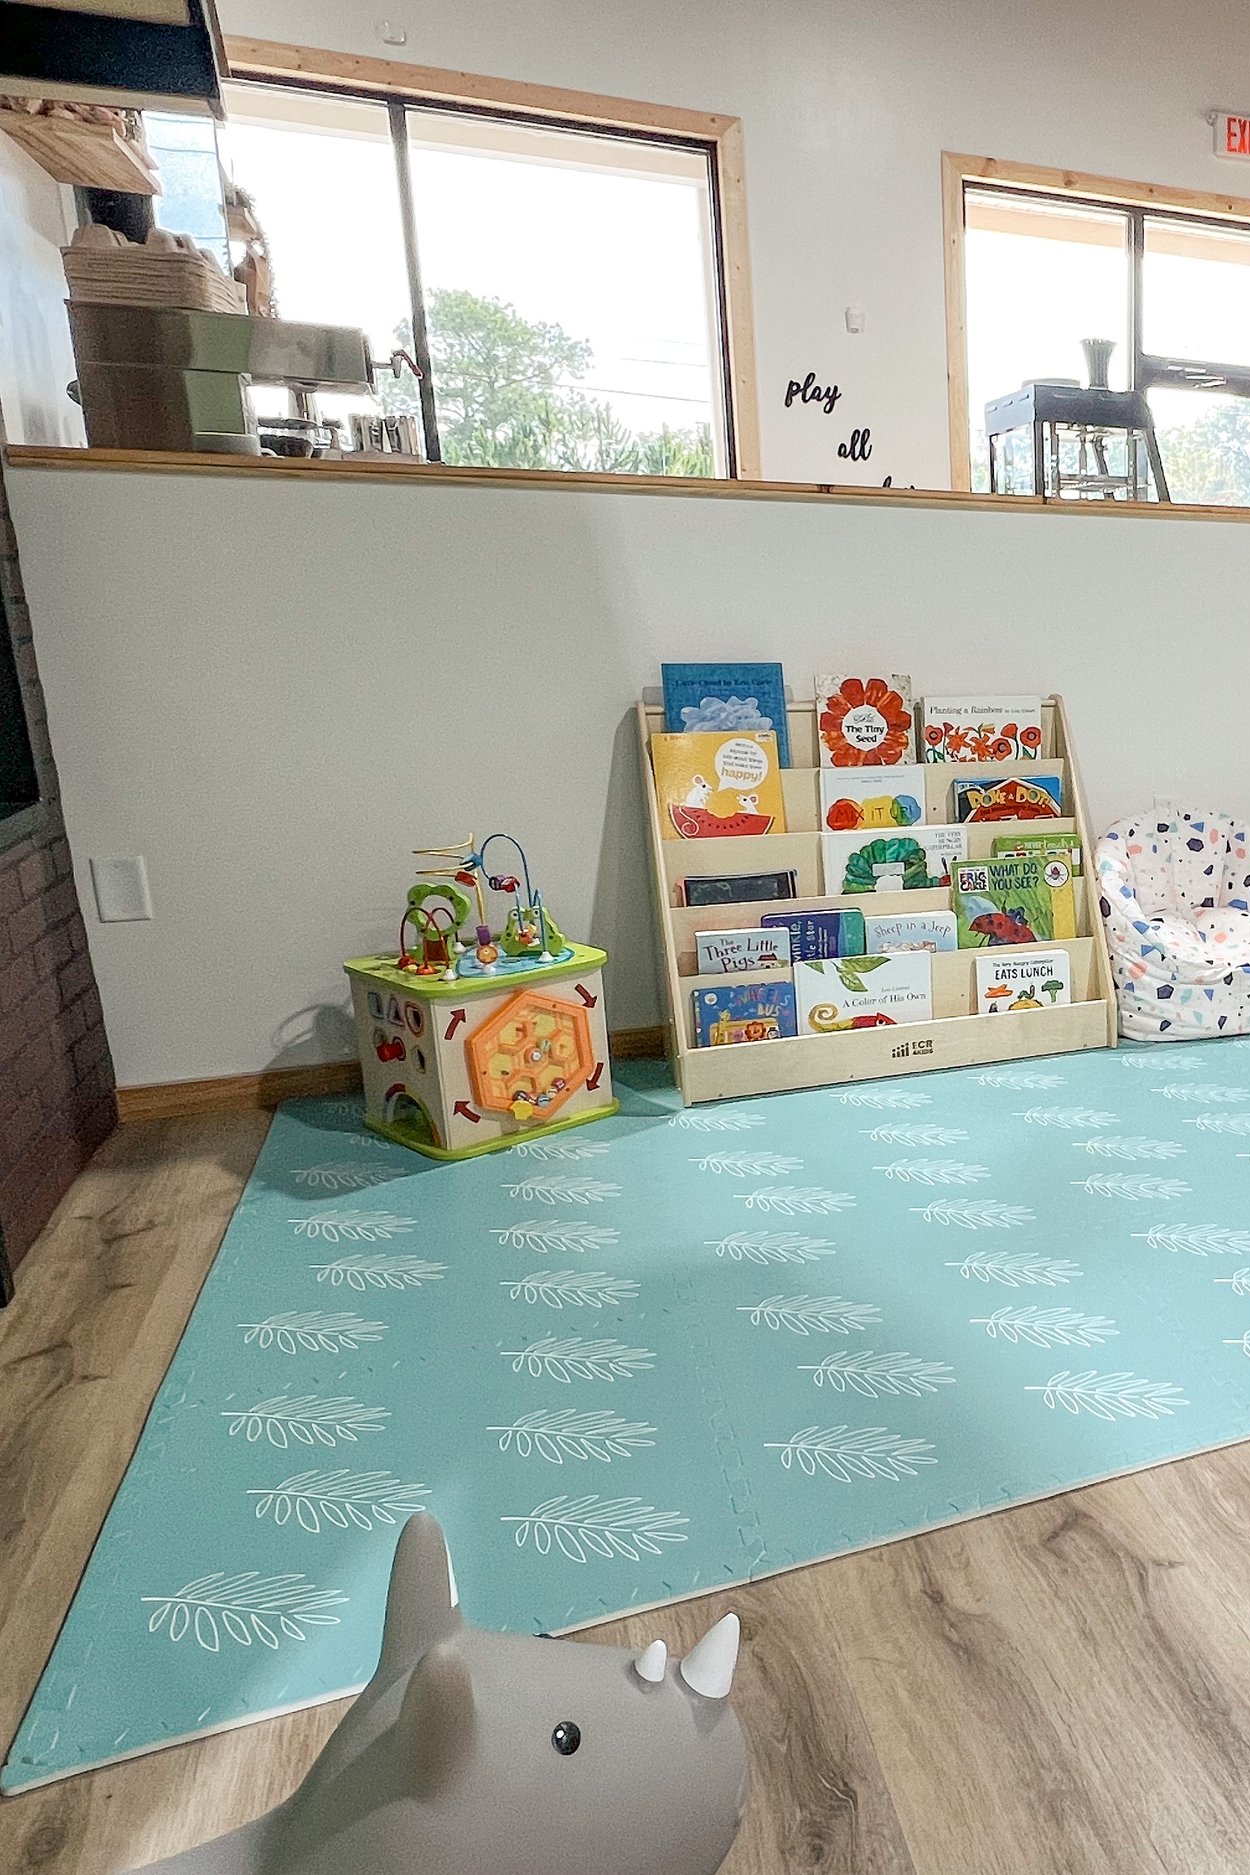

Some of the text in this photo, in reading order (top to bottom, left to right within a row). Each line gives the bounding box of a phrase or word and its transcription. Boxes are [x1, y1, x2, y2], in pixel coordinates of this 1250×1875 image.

[784, 372, 842, 414] play
[837, 428, 872, 461] all
[930, 706, 962, 715] Planting
[845, 725, 885, 735] The Tiny
[721, 767, 762, 782] happy!
[966, 789, 1008, 809] POKE
[871, 807, 884, 821] IT
[990, 863, 1037, 876] WHAT DO
[993, 876, 1039, 890] YOU SEE?
[874, 920, 951, 938] Sheep in a Jeep
[702, 938, 778, 960] Three Little
[720, 938, 734, 946] The
[720, 956, 755, 972] Pigs
[995, 966, 1053, 980] EATS LUNCH
[842, 992, 927, 1008] A Color of His Own
[912, 1039, 933, 1049] ECR
